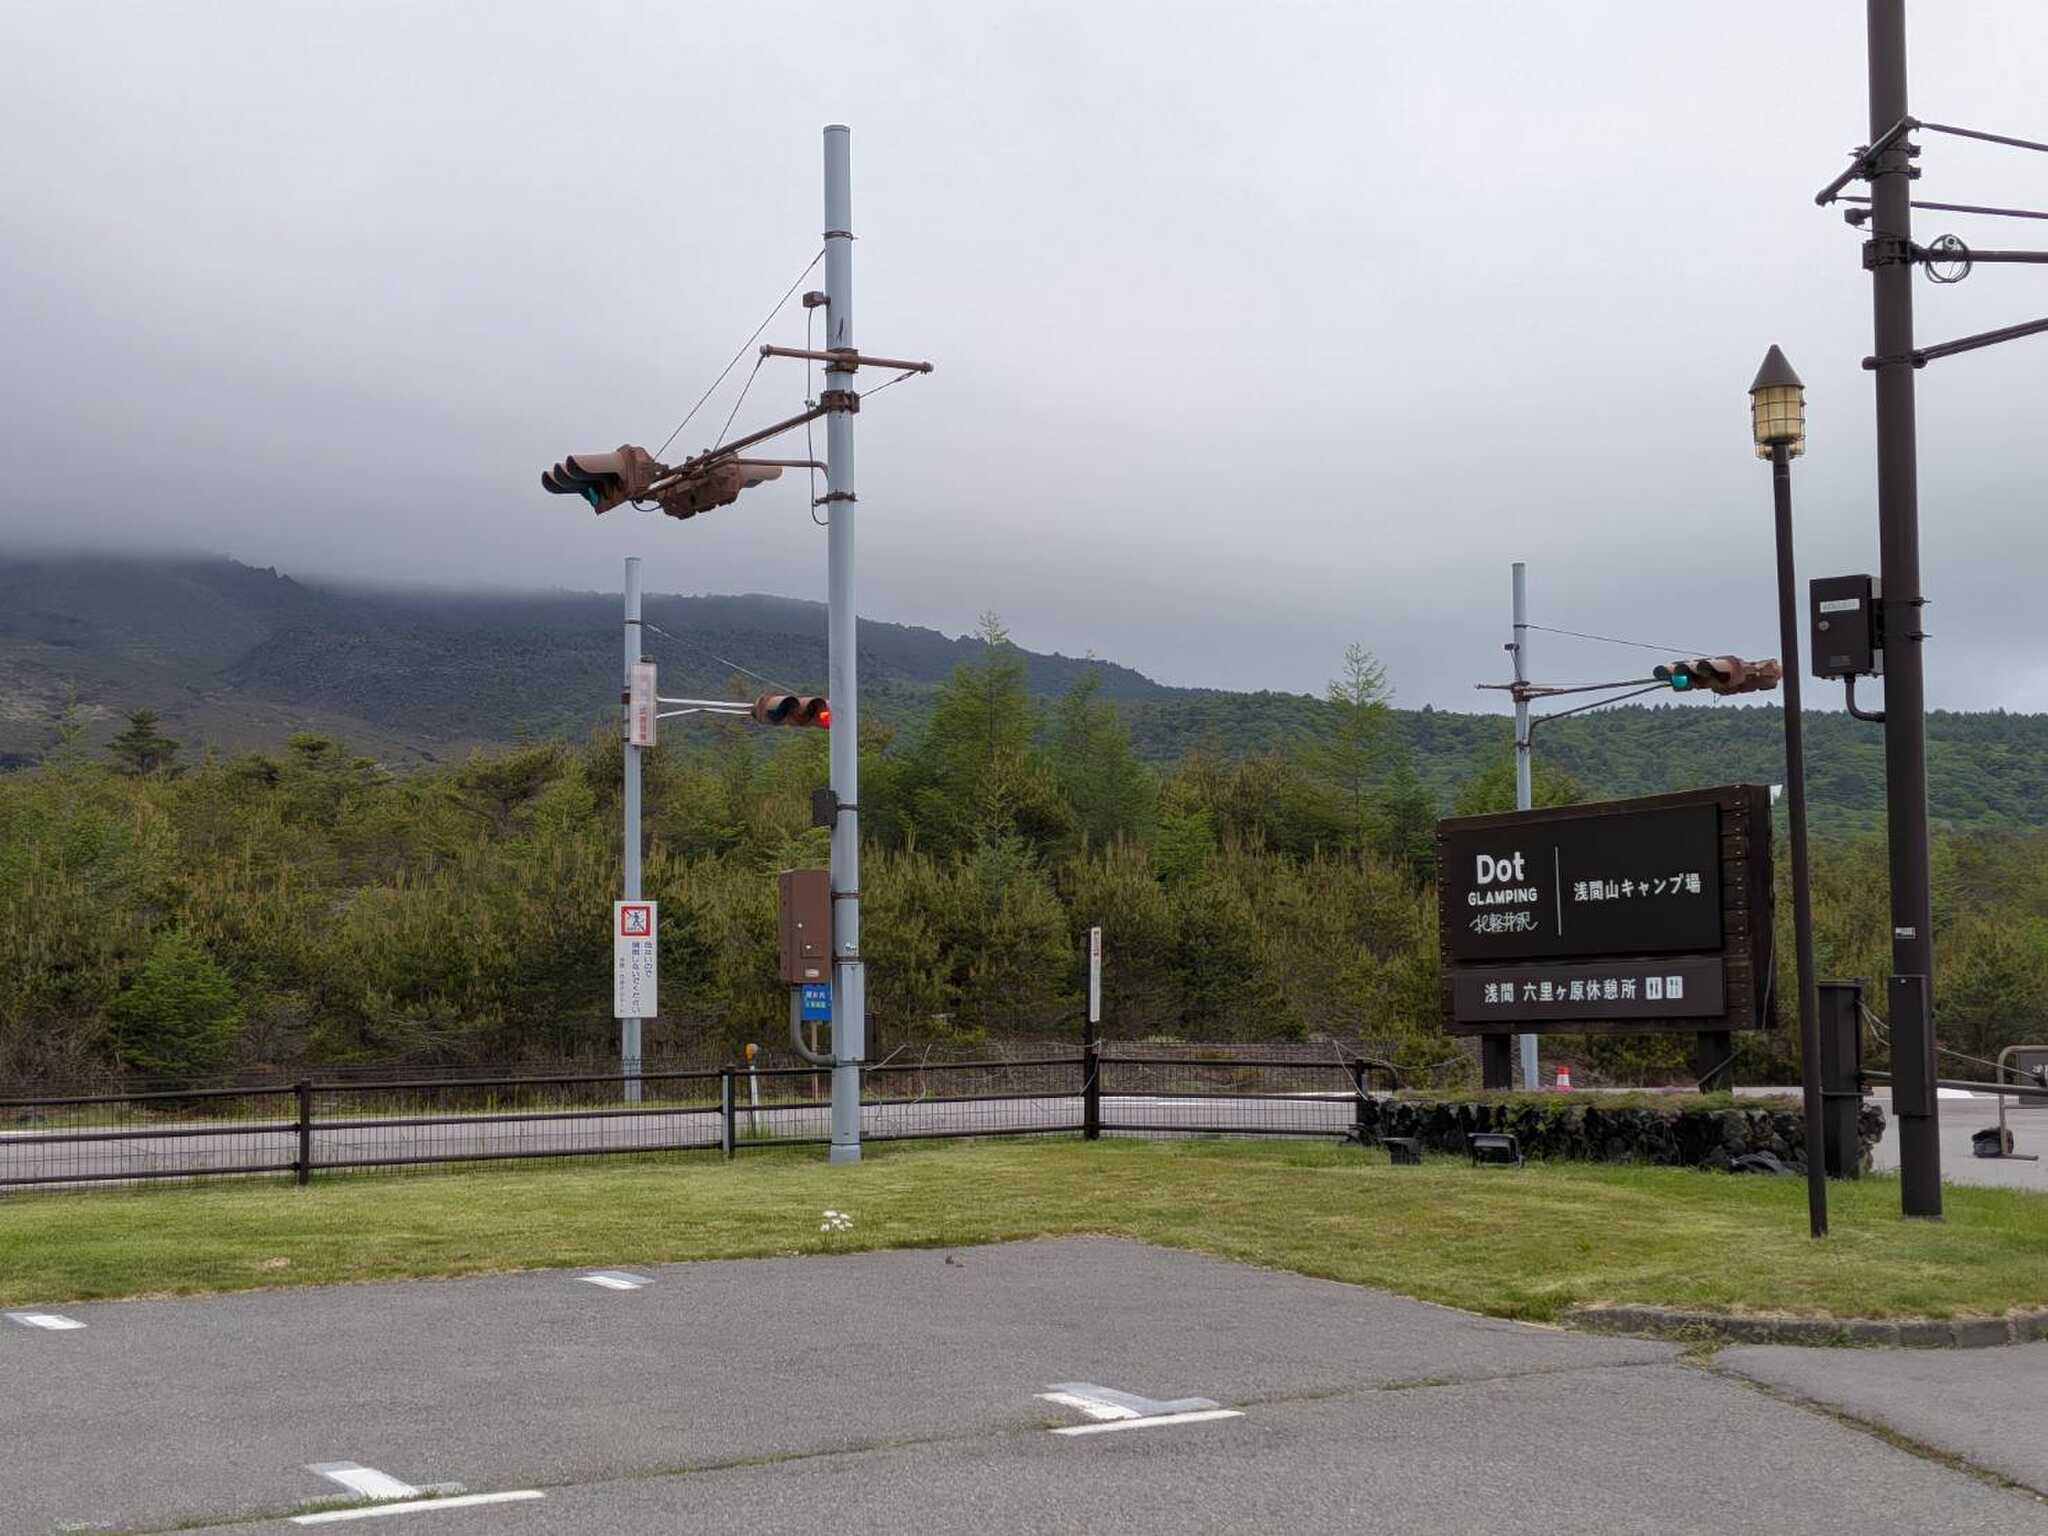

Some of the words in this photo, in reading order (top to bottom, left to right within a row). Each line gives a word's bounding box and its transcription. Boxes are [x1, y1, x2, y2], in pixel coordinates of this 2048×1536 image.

[1476, 851, 1525, 885] Dot
[1467, 888, 1538, 906] GLAMPING
[1573, 873, 1702, 902] 浅間山キャンプ場
[1484, 982, 1515, 1003] 浅間
